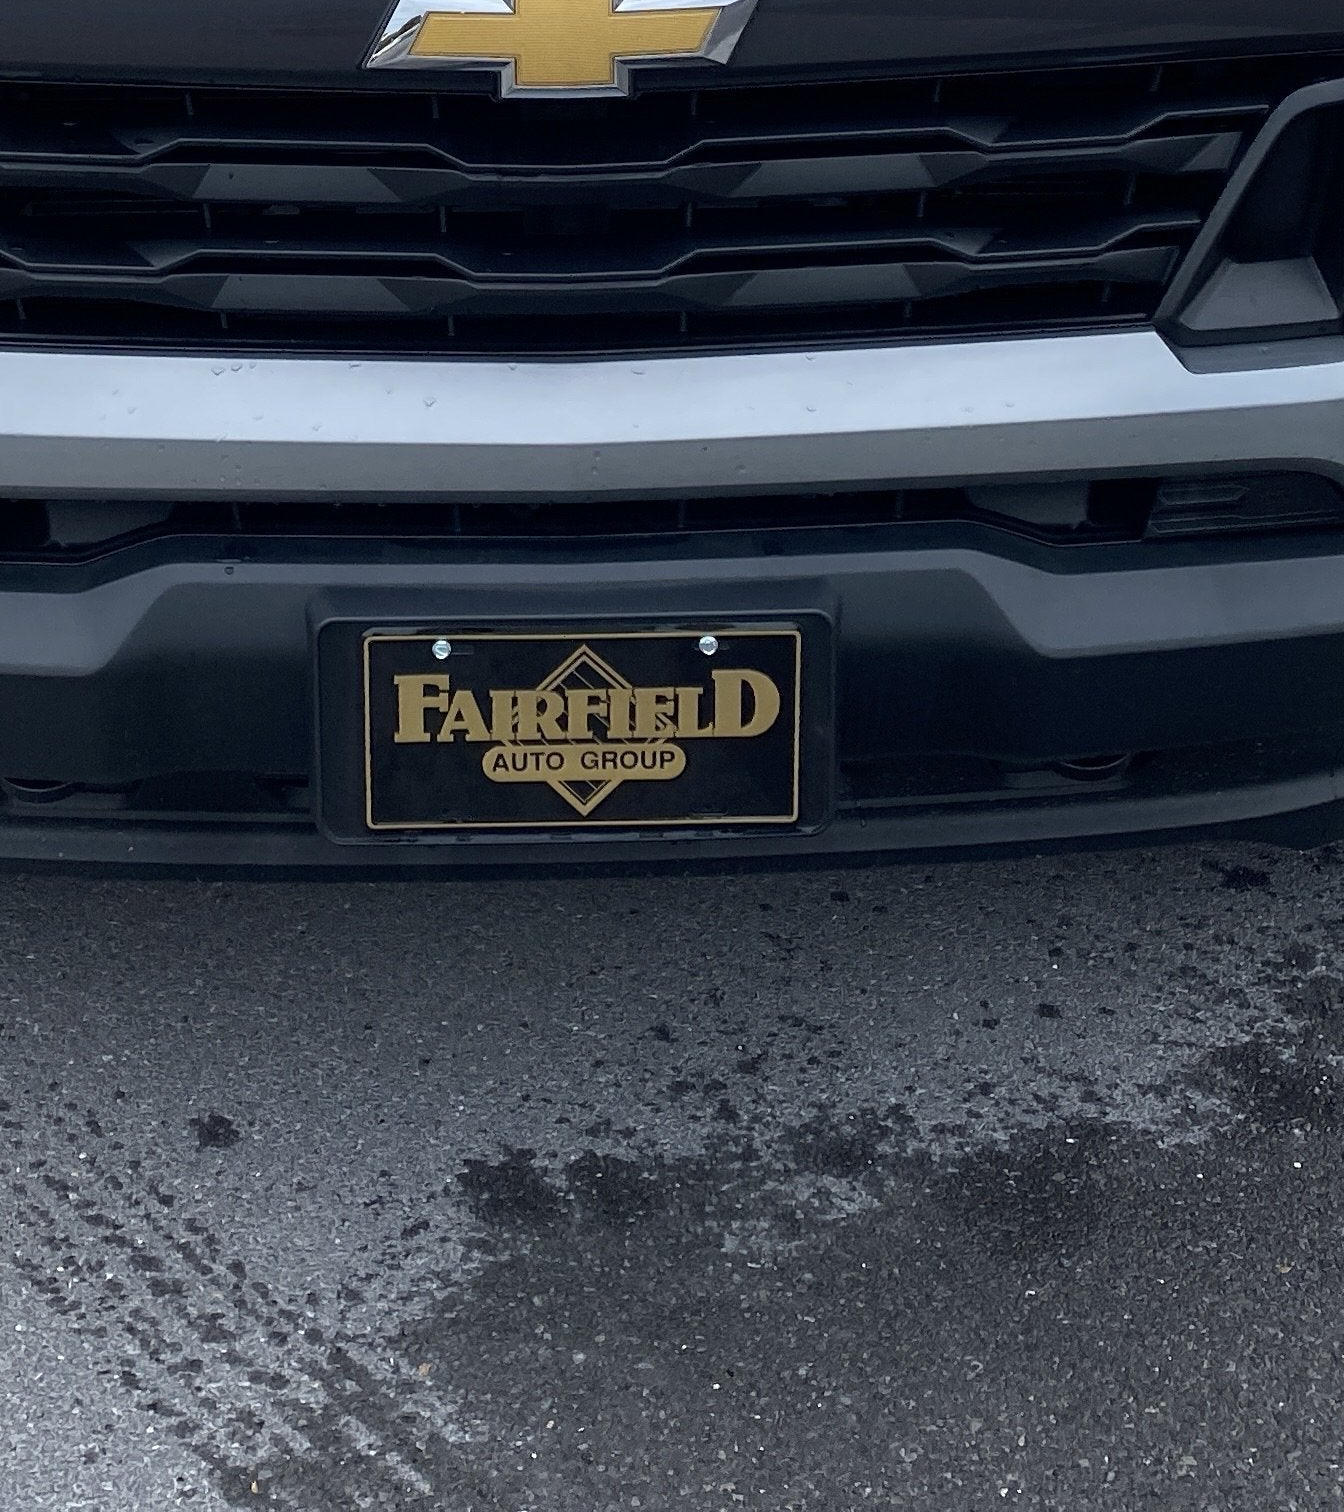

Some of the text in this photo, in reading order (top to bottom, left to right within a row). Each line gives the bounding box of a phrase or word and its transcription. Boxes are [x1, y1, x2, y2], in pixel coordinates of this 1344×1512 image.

[393, 668, 781, 743] FAIRFIELD
[492, 748, 676, 772] AUTO GROUP
